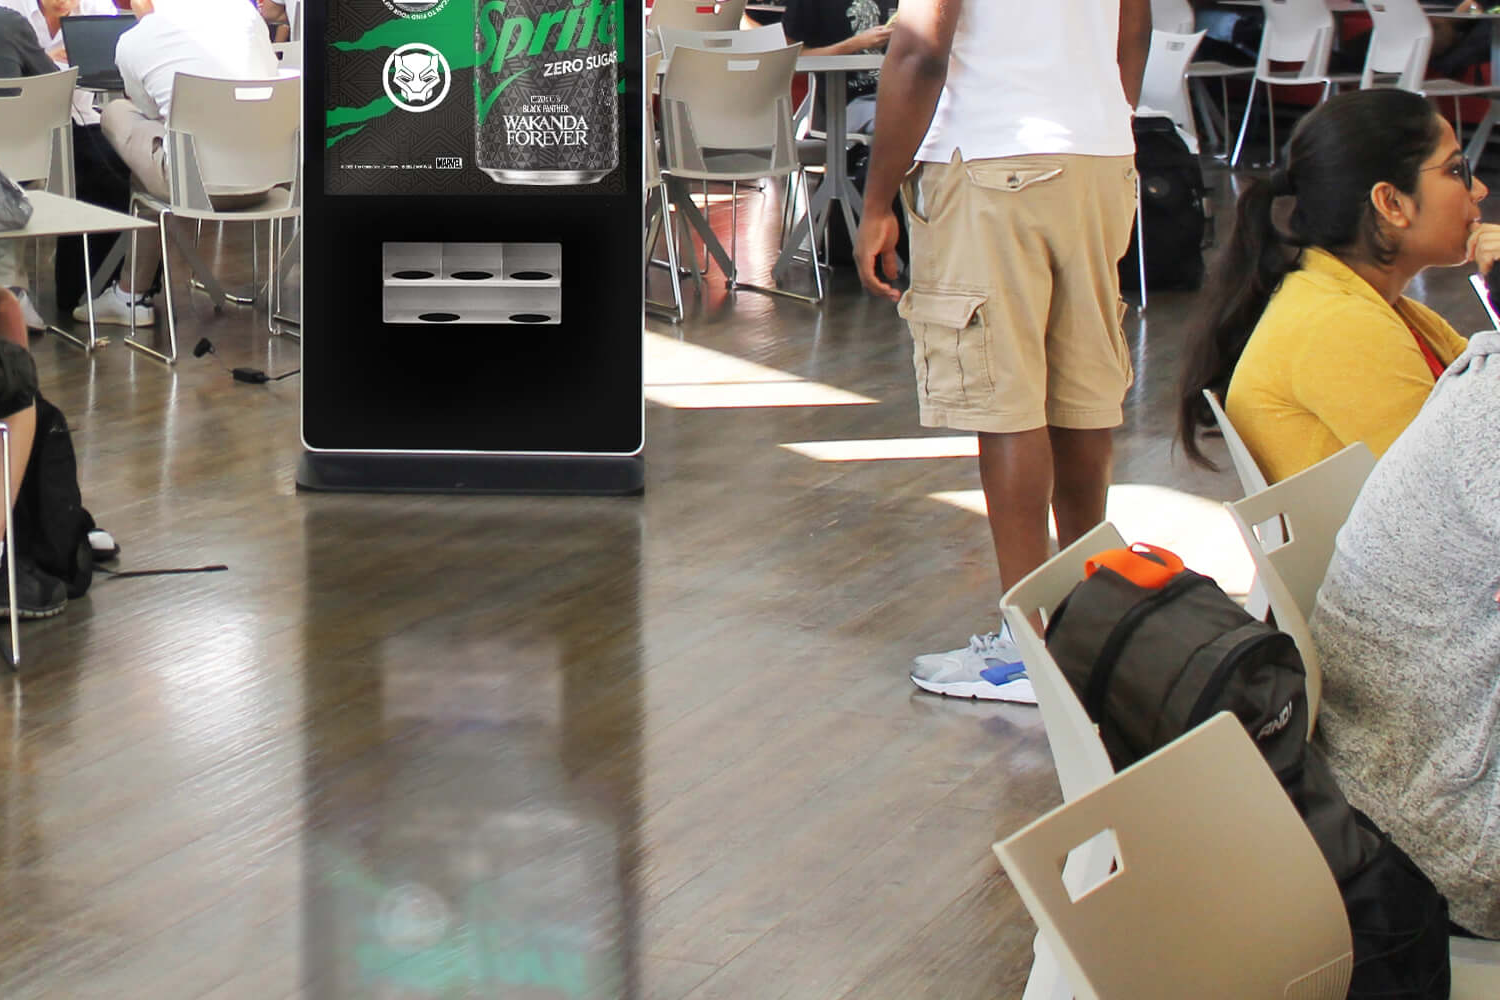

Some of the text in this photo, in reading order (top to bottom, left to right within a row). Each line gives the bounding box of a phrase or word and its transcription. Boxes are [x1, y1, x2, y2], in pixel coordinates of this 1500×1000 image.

[543, 58, 584, 77] ZERO
[522, 104, 569, 113] BLACK PANTHER
[502, 114, 589, 130] WAKANDA
[506, 130, 588, 147] FOREVER
[436, 157, 462, 169] MARVEL
